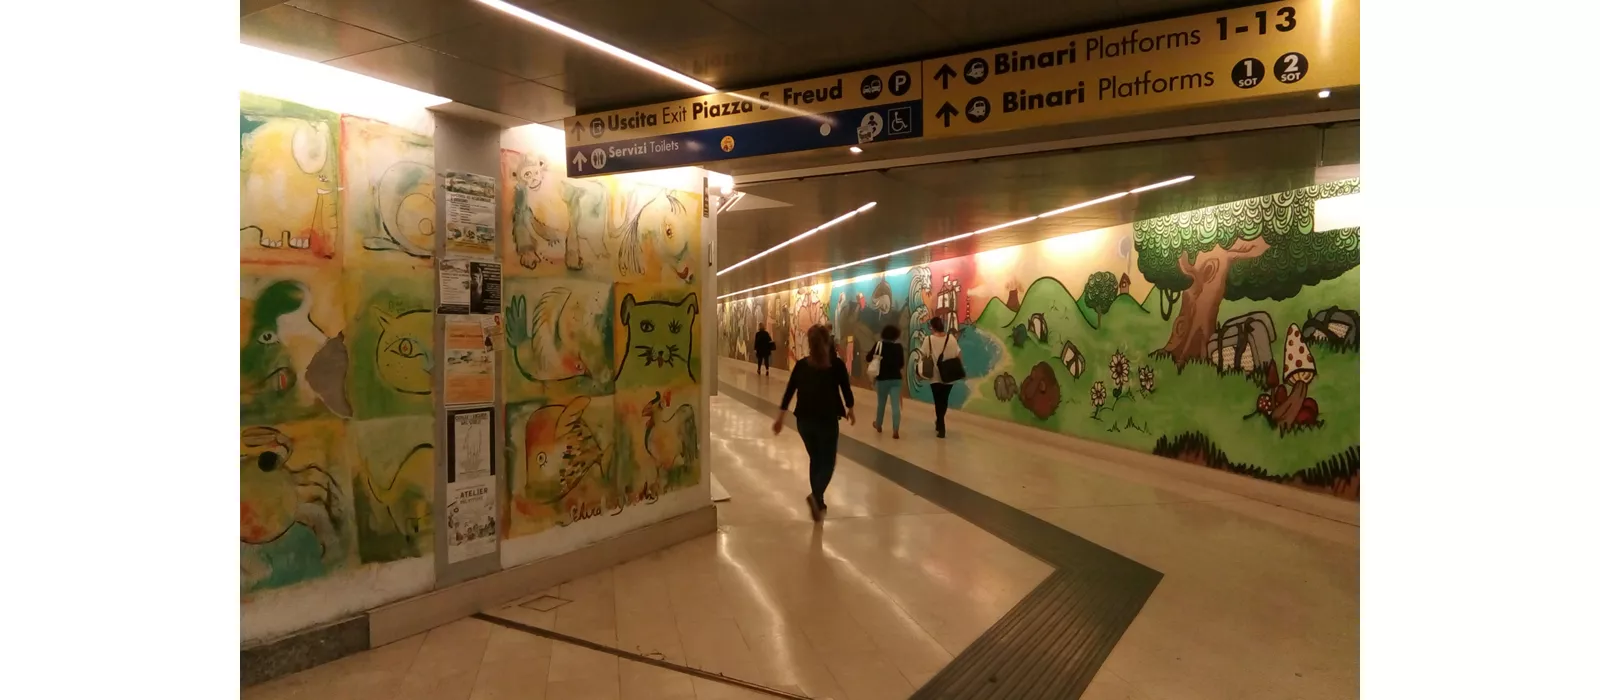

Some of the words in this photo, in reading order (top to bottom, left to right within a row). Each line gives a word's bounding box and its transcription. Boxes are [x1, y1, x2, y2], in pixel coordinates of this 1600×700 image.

[994, 41, 1076, 75] Binari
[1086, 29, 1201, 61] Platforms
[1216, 6, 1297, 41] 1-13
[1244, 60, 1253, 77] 1
[1283, 54, 1299, 73] 2
[895, 75, 907, 92] P
[1238, 77, 1258, 87] SOT
[1281, 72, 1301, 82] SOT
[1002, 81, 1085, 114] Binari
[1099, 70, 1215, 100] Platforms
[607, 111, 657, 131] Uscita
[662, 106, 687, 125] Exit
[692, 101, 753, 120] Piazza
[783, 79, 843, 106] Freud
[608, 142, 648, 158] Servizi
[650, 140, 679, 153] Toilets
[460, 487, 488, 499] ATELIER
